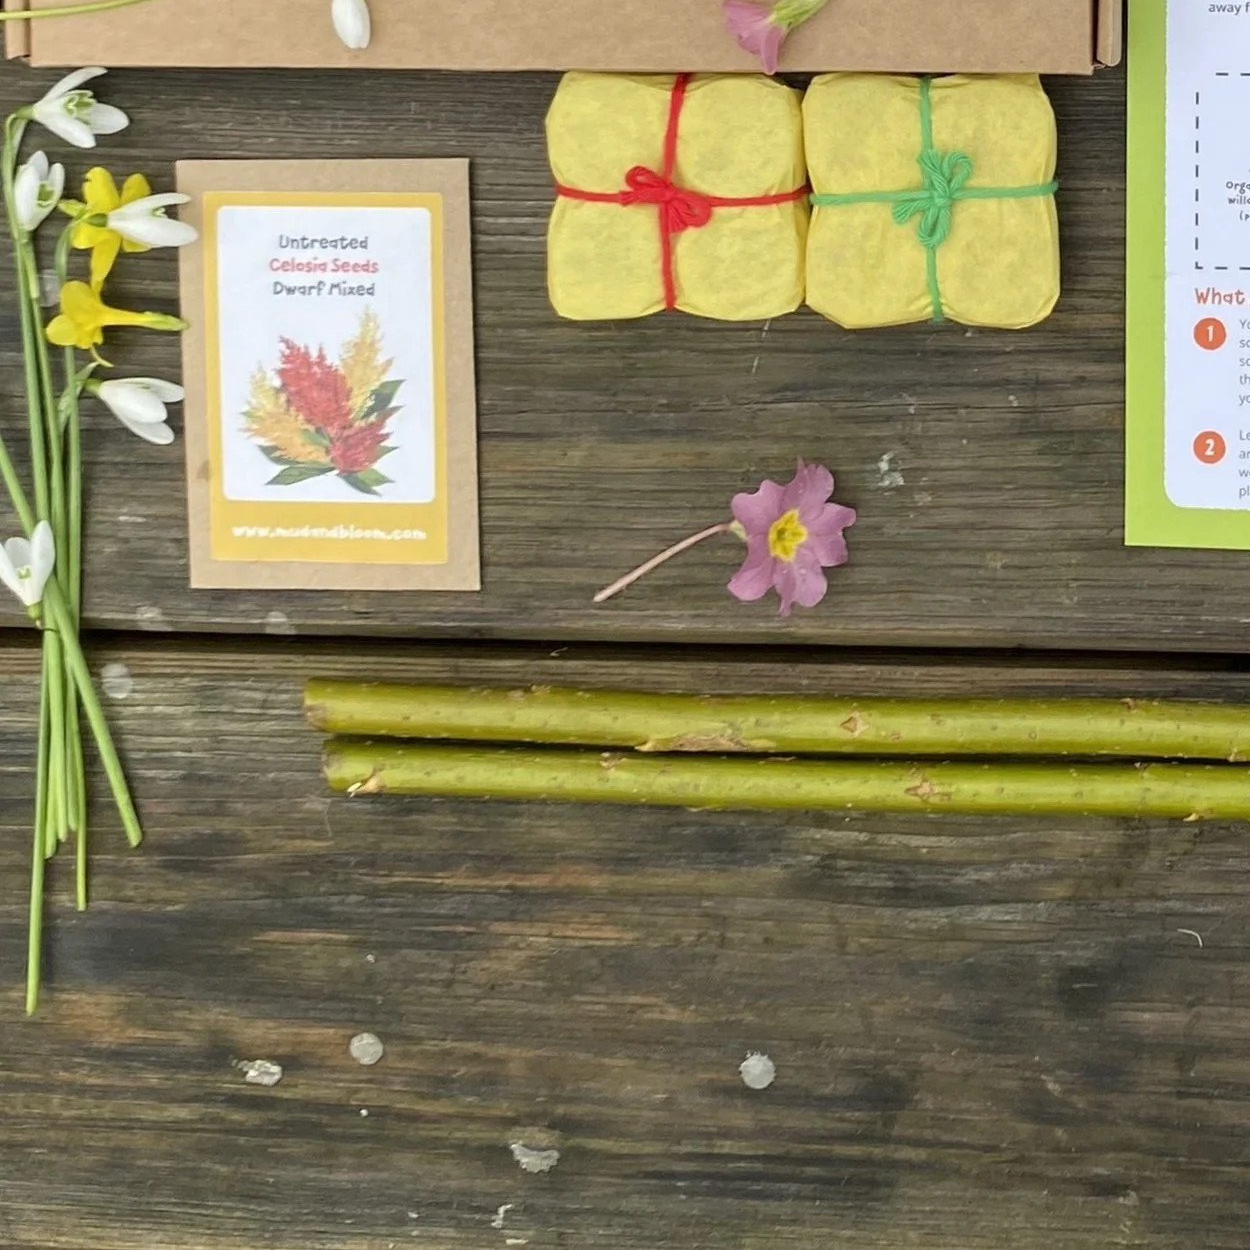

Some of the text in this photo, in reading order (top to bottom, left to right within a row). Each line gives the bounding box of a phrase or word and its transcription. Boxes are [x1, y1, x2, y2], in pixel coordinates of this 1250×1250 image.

[279, 234, 368, 249] Untreated
[269, 257, 379, 273] Celosia Seeds
[273, 280, 375, 296] Dwarf Mixed
[1195, 287, 1245, 305] What
[1207, 325, 1213, 341] 1
[1205, 439, 1214, 455] 2
[232, 524, 426, 540] www.mudandbloom.com
